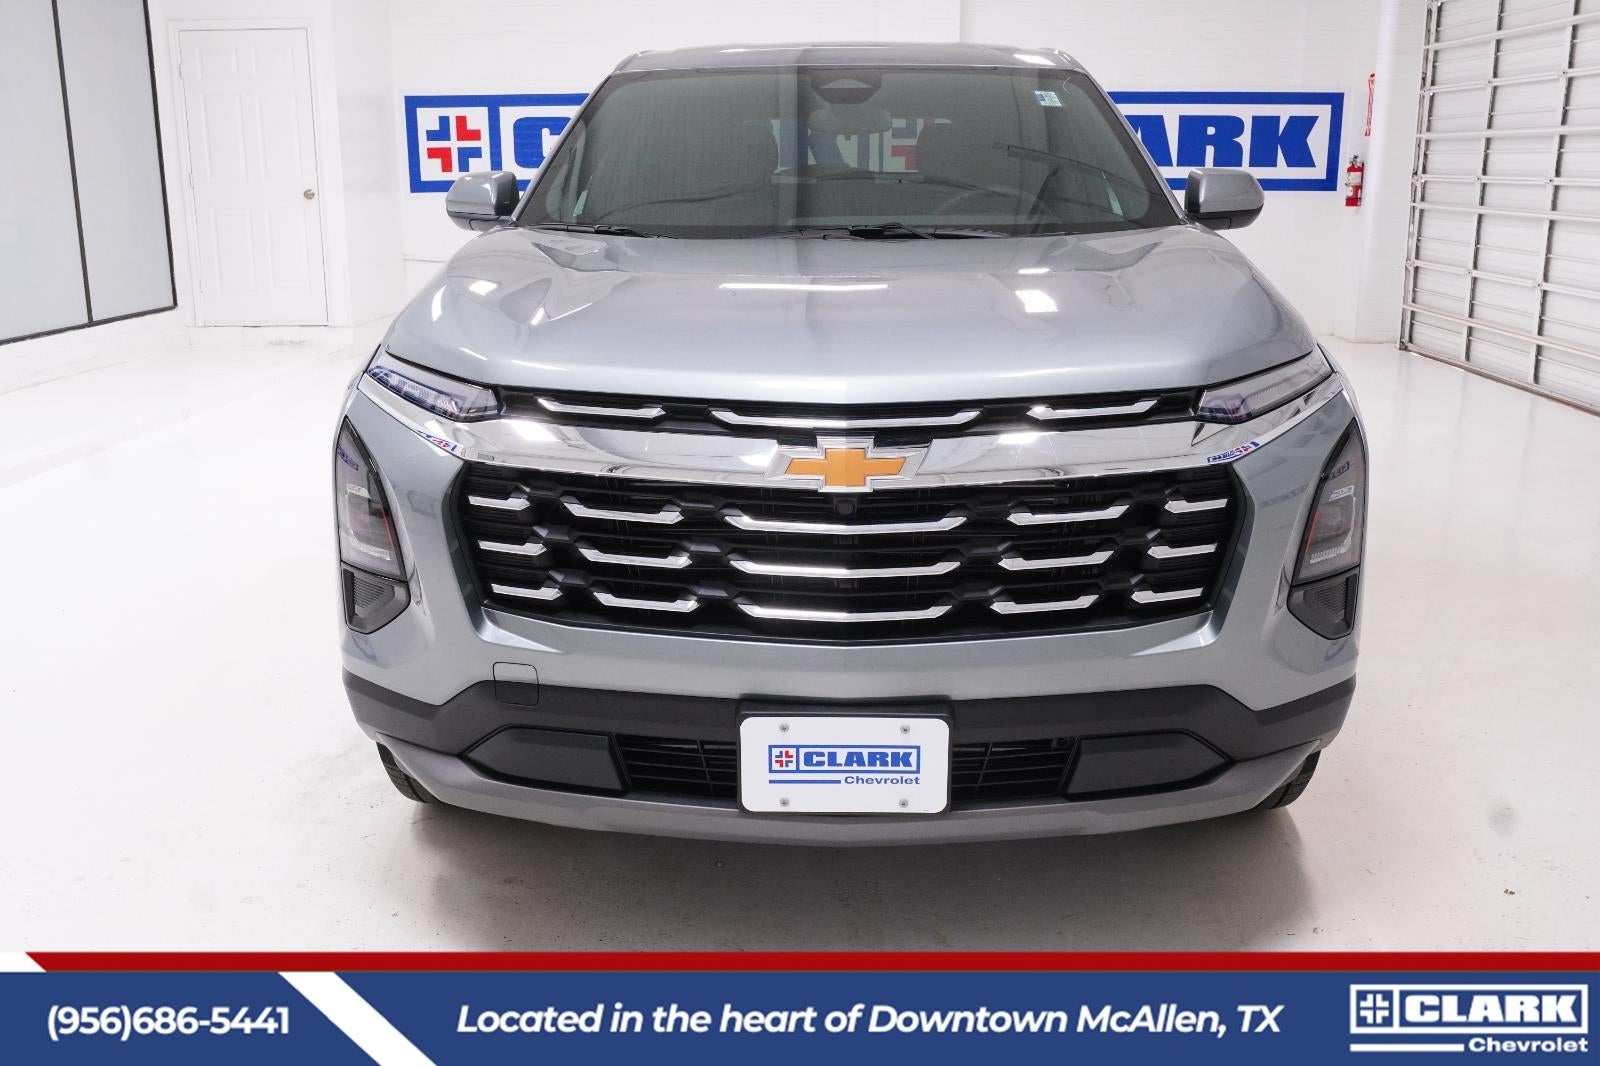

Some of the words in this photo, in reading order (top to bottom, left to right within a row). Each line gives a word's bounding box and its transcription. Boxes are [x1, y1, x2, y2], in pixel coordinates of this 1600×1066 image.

[1123, 114, 1319, 168] ARK
[803, 751, 913, 767] CLARK
[844, 775, 921, 785] Chevrolet
